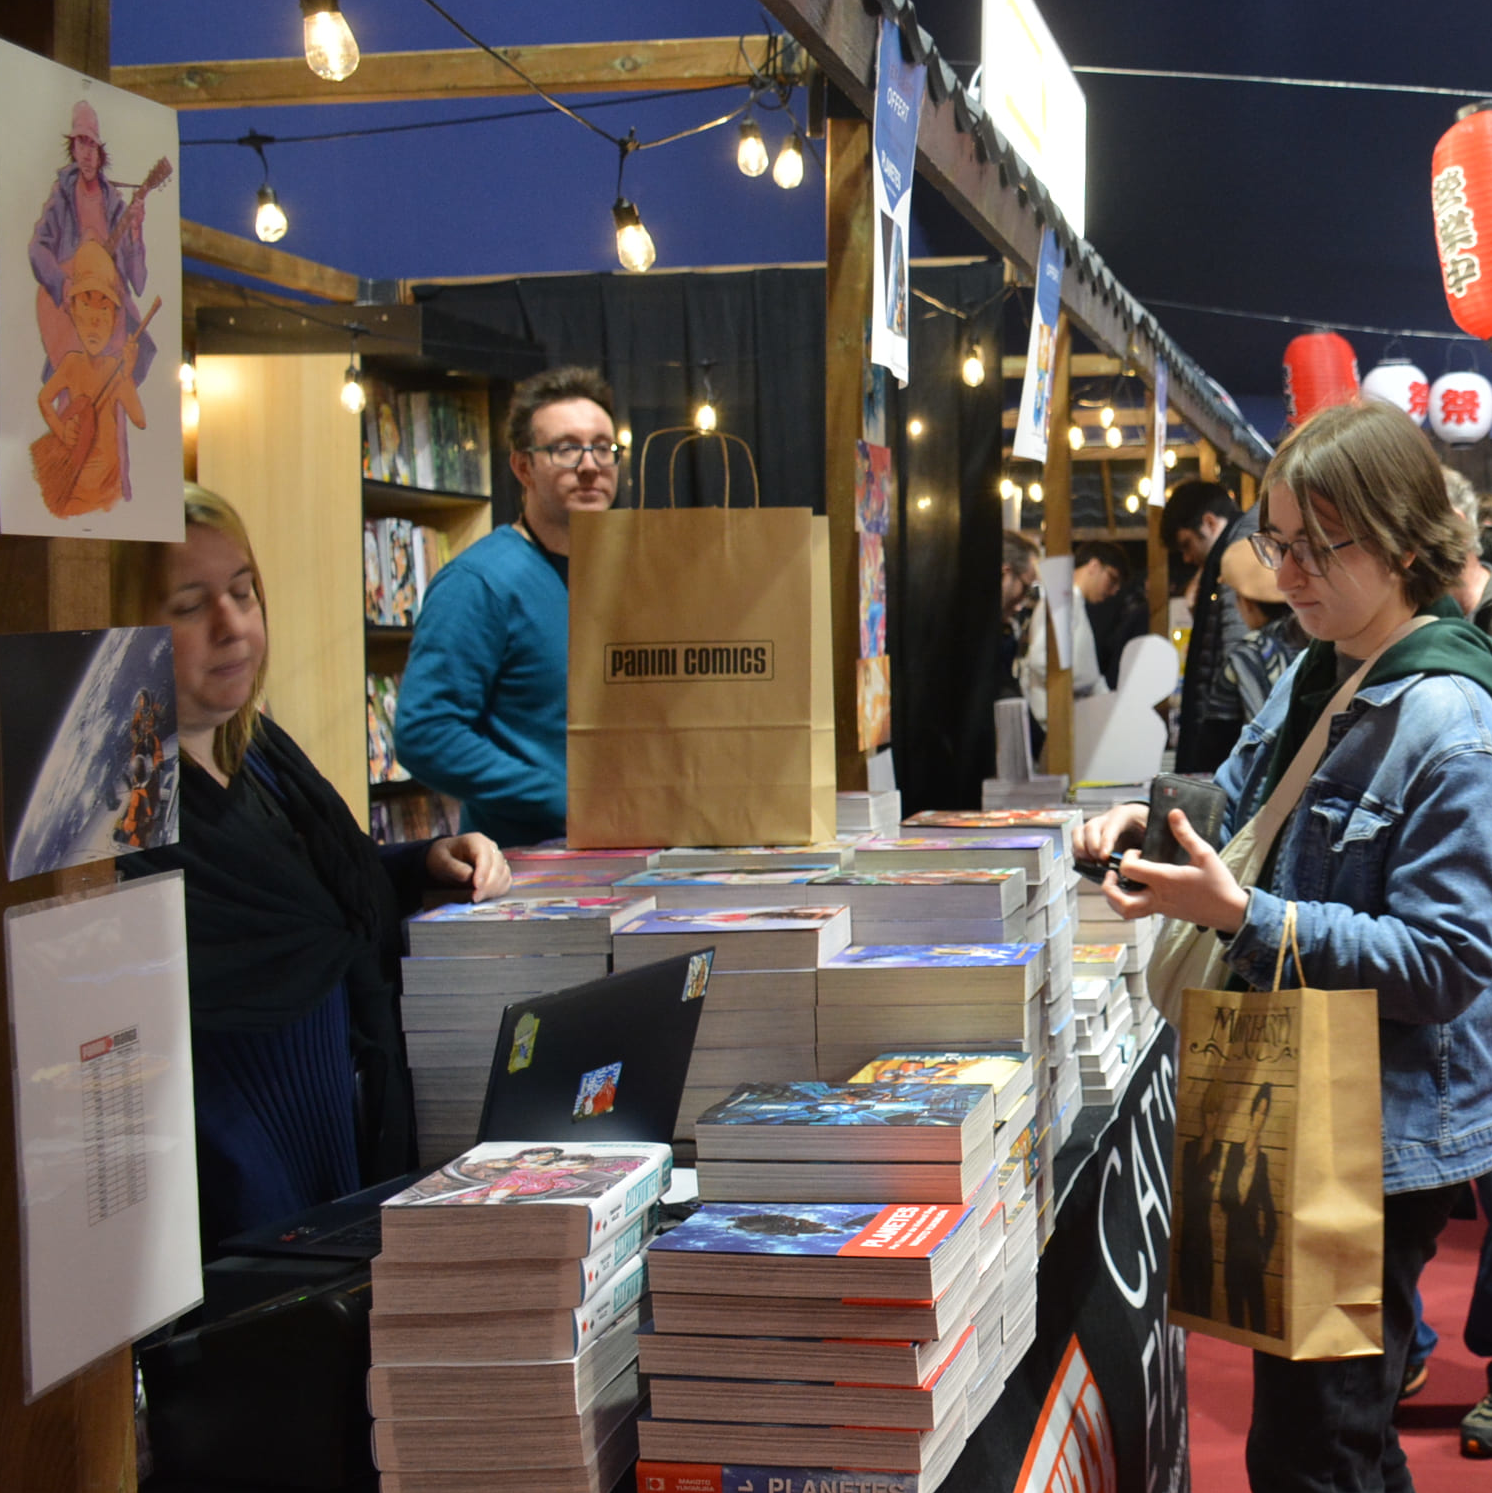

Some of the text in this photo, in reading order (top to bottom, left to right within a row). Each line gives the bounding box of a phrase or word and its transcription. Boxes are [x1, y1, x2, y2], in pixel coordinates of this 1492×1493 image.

[887, 87, 910, 123] OFFERT
[1442, 389, 1480, 426] 祭
[611, 647, 766, 677] PANINI COMICS
[860, 1206, 920, 1247] PLANETES
